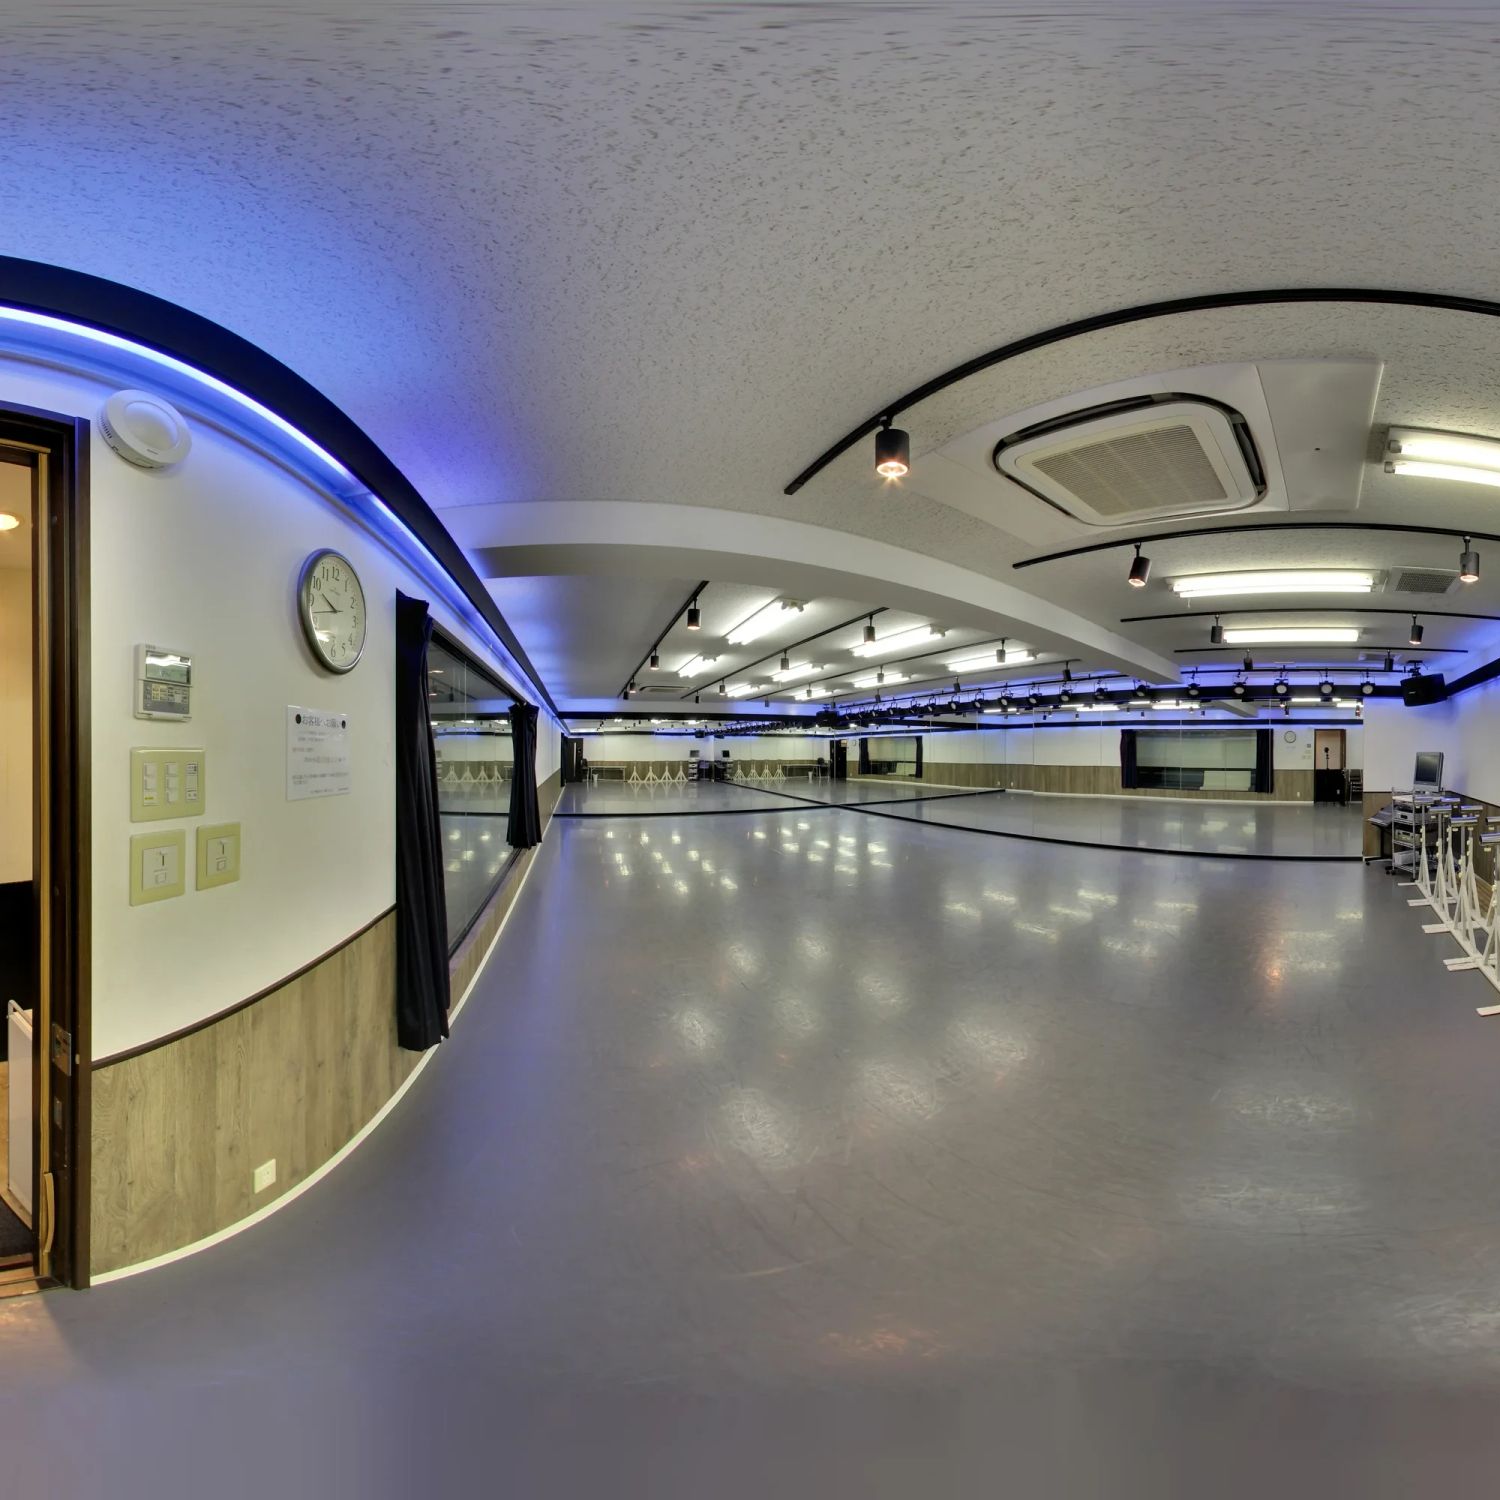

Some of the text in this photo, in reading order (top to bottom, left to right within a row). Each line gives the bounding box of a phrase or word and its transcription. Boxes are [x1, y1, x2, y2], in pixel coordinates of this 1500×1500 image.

[322, 566, 329, 581] 11
[332, 566, 340, 581] 12
[313, 576, 321, 591] 10
